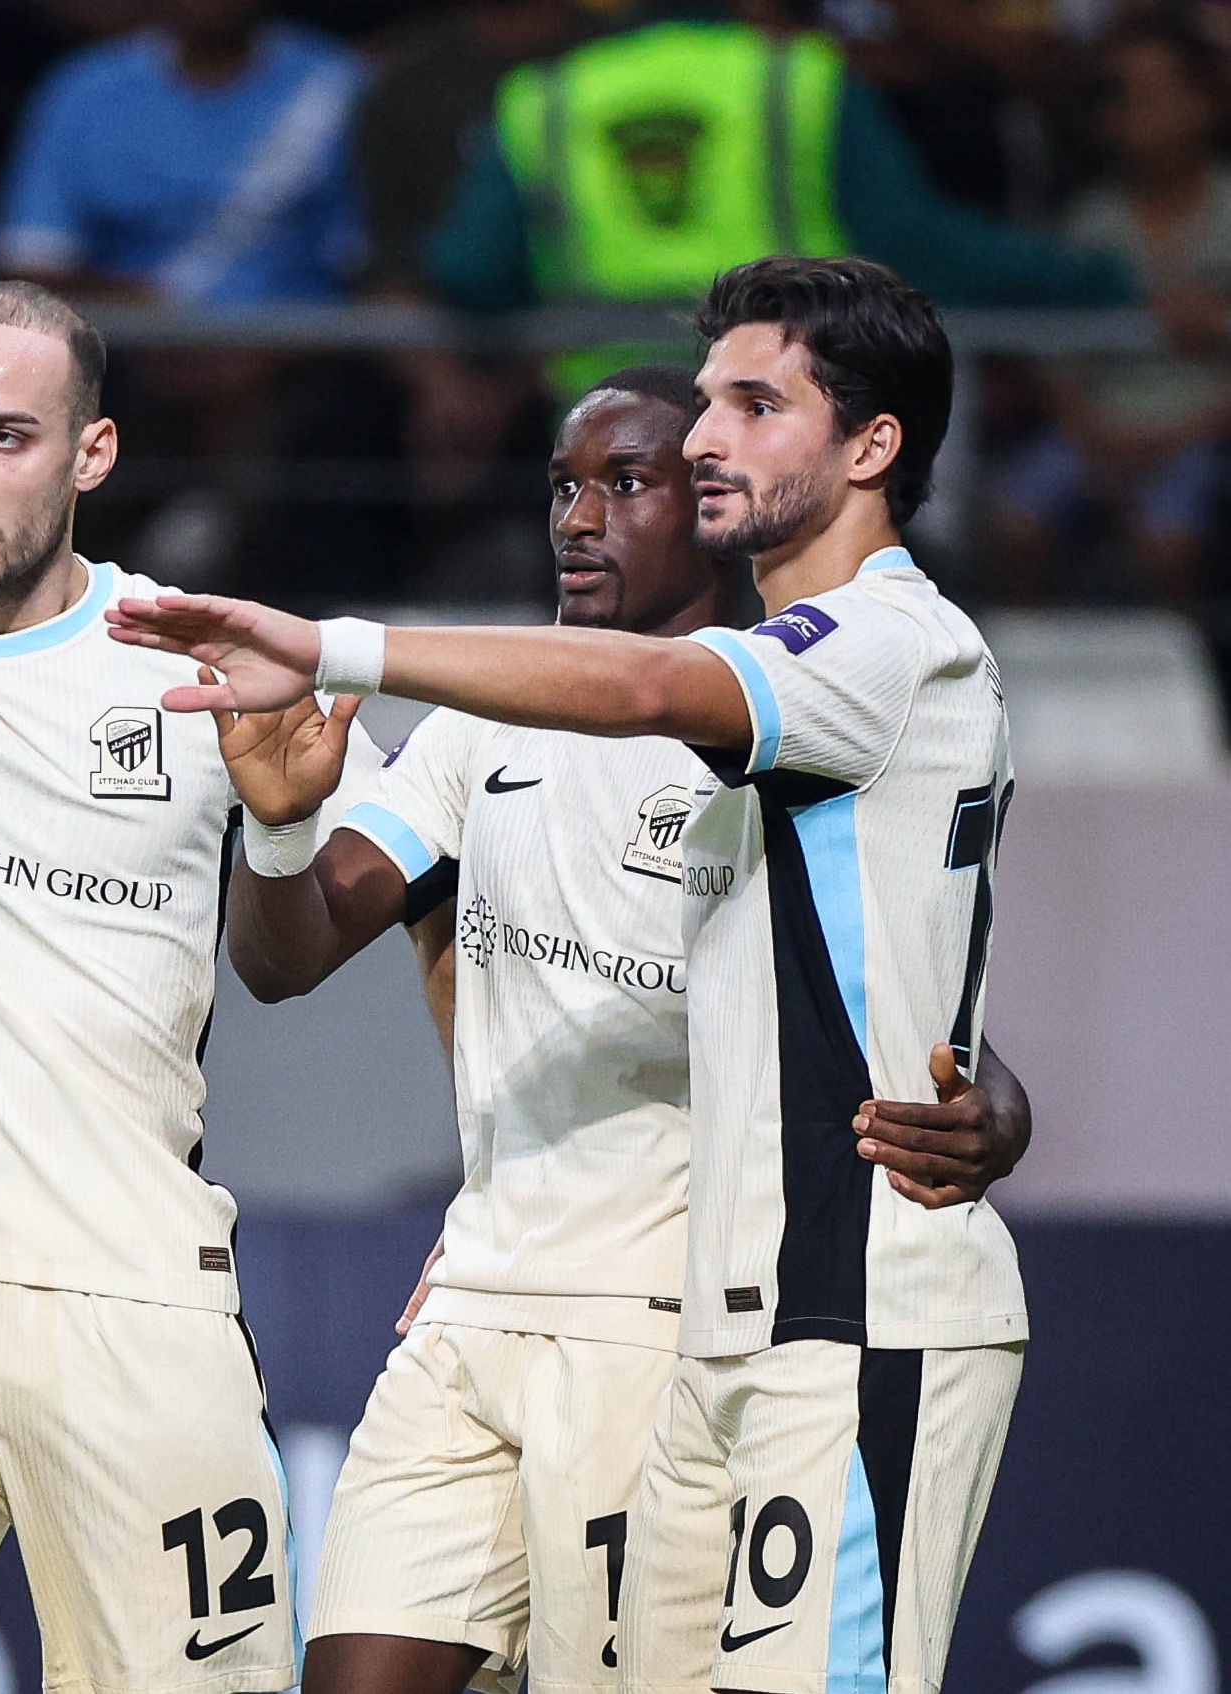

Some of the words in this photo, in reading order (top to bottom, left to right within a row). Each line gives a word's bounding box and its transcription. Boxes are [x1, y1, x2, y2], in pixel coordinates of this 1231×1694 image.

[99, 777, 135, 785] ITTIHAD
[137, 778, 160, 786] CLUB
[47, 868, 173, 911] GROUP
[503, 923, 589, 973] ROSHN
[592, 951, 687, 994] GROU
[161, 1497, 276, 1619] 12
